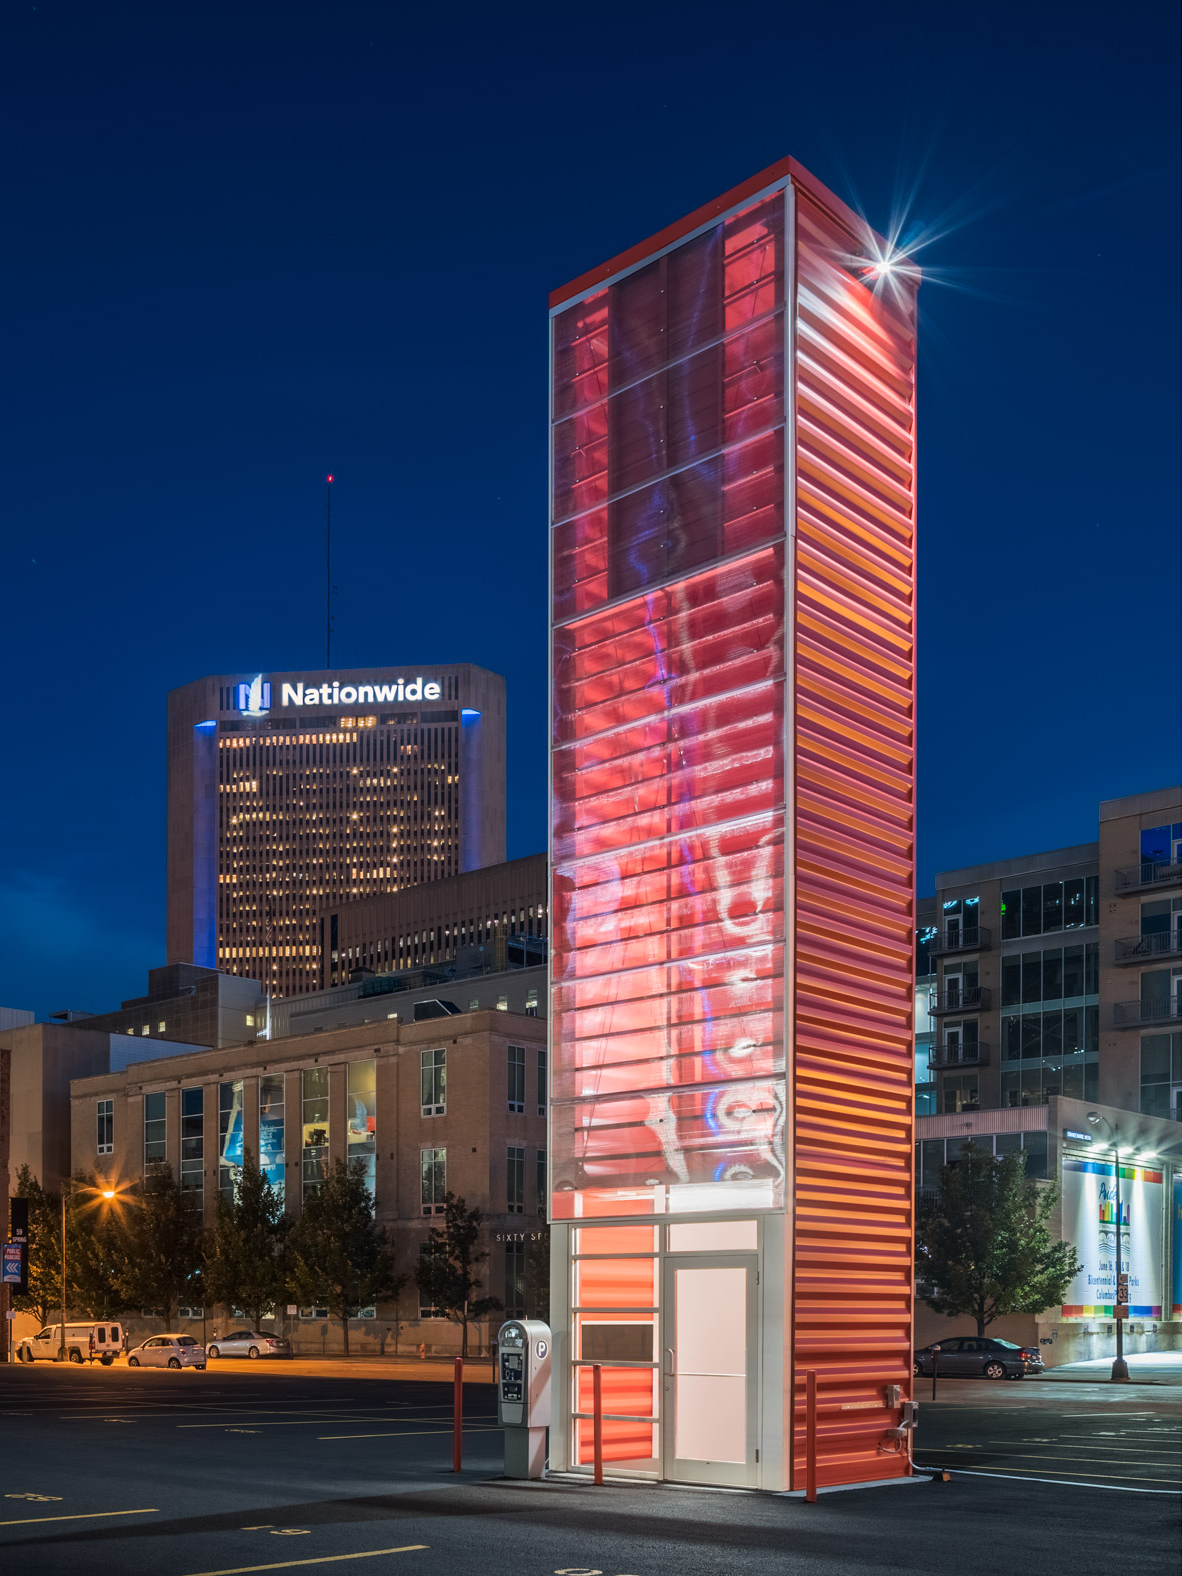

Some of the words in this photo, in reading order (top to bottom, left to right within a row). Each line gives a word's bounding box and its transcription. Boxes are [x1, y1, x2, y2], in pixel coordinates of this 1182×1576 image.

[282, 677, 440, 706] Nationwide
[496, 1233, 525, 1242] SIXTY
[1099, 1260, 1108, 1271] June
[1088, 1274, 1112, 1285] Bicentennial
